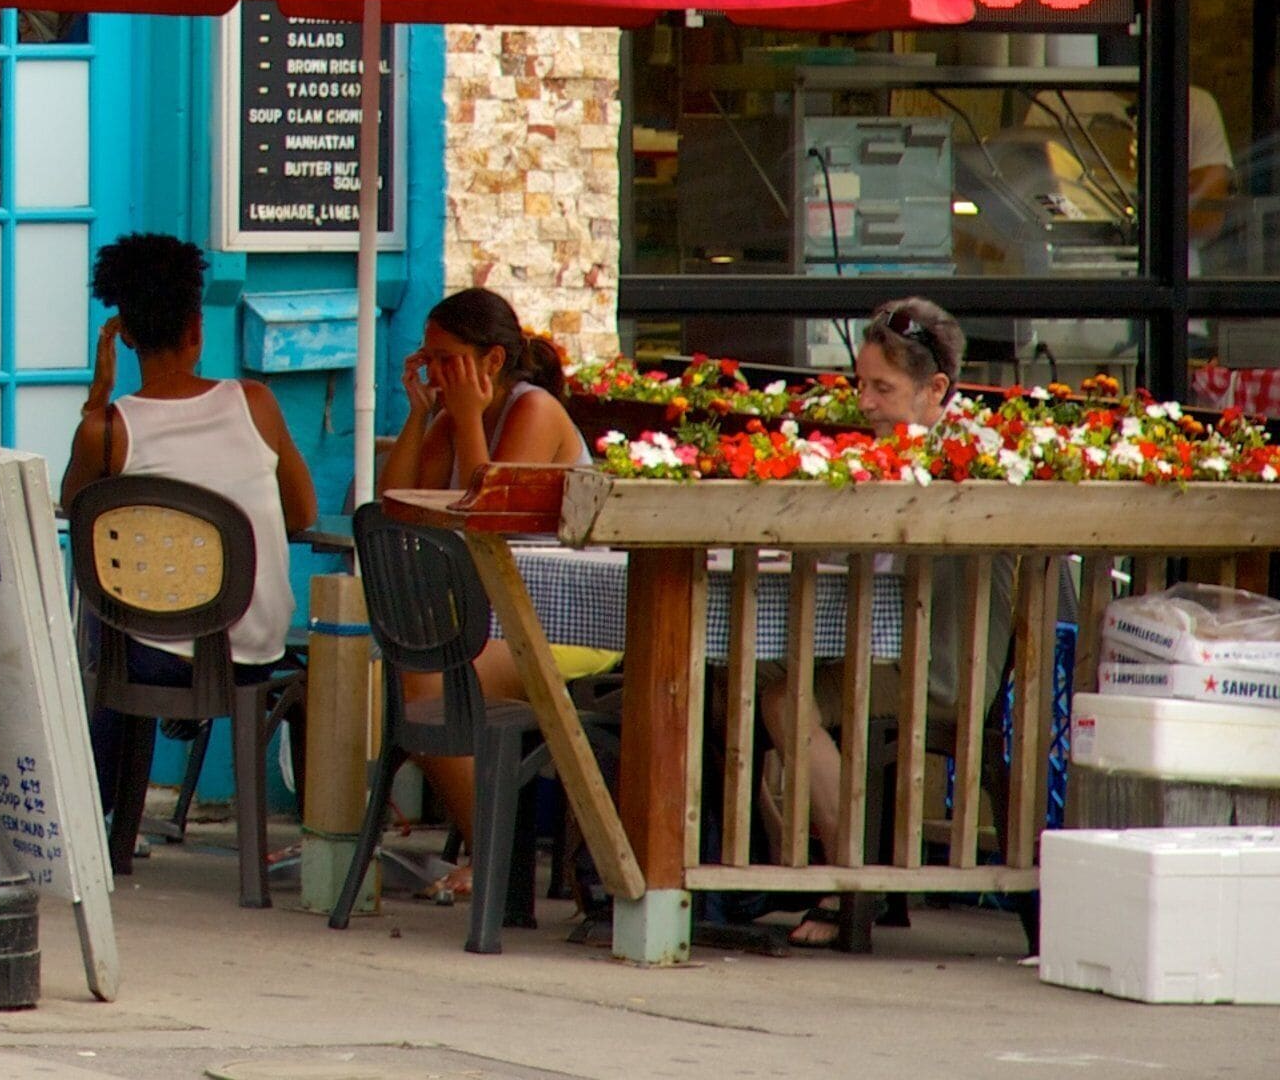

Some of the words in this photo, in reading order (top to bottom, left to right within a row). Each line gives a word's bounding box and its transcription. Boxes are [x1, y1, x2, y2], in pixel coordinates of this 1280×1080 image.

[287, 32, 344, 48] SALADS
[287, 59, 328, 75] BROWN
[330, 59, 357, 75] RICE
[248, 108, 282, 124] SOUP
[287, 108, 323, 124] CLAM
[285, 135, 355, 150] MANHATTAN
[284, 161, 332, 176] BUTTER
[334, 161, 359, 176] NUT
[321, 204, 360, 221] LIMEA
[1221, 679, 1280, 700] SANPELL
